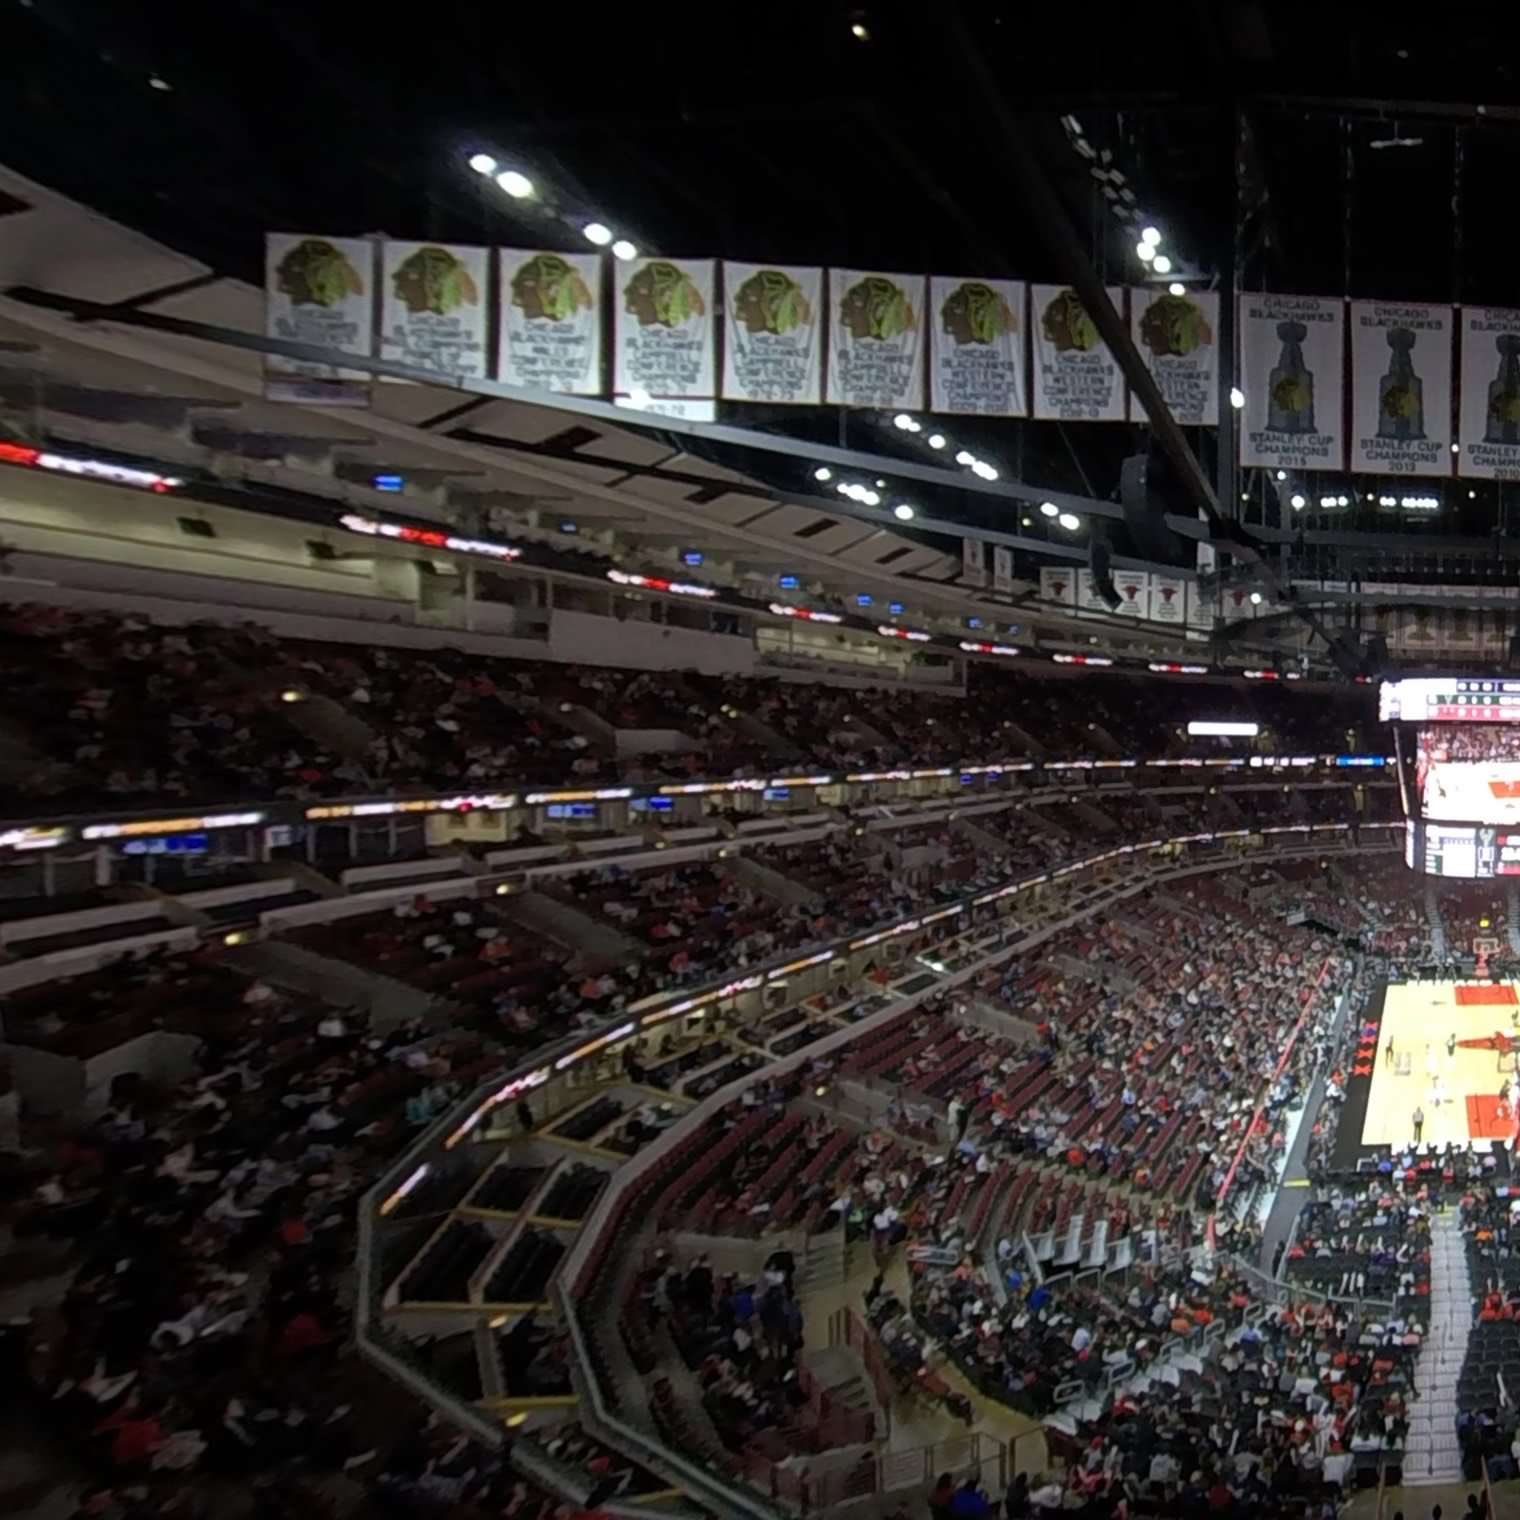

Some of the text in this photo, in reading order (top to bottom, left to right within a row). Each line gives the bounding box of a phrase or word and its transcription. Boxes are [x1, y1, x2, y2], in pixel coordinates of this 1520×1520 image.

[1264, 299, 1320, 311] CHICAGO
[1249, 308, 1335, 323] BLACKHAWKS
[1374, 306, 1430, 319] CHICAGO
[1360, 316, 1444, 331] BLACKHAWKS
[953, 349, 999, 359] CHICAGO
[1055, 354, 1101, 365] CHICAGO
[942, 357, 1014, 372] BLACKHAWKS
[1042, 364, 1114, 377] BLACKHAWKS
[952, 369, 1005, 381] WESTERN
[1053, 374, 1104, 386] WESTERN
[1250, 432, 1334, 446] STANLEY CUP
[1254, 444, 1329, 457] CHAMPIONS
[1360, 439, 1443, 453] STANLEY CUP
[1468, 444, 1519, 458] STANLEY
[1366, 451, 1438, 464] CHAMPIONS
